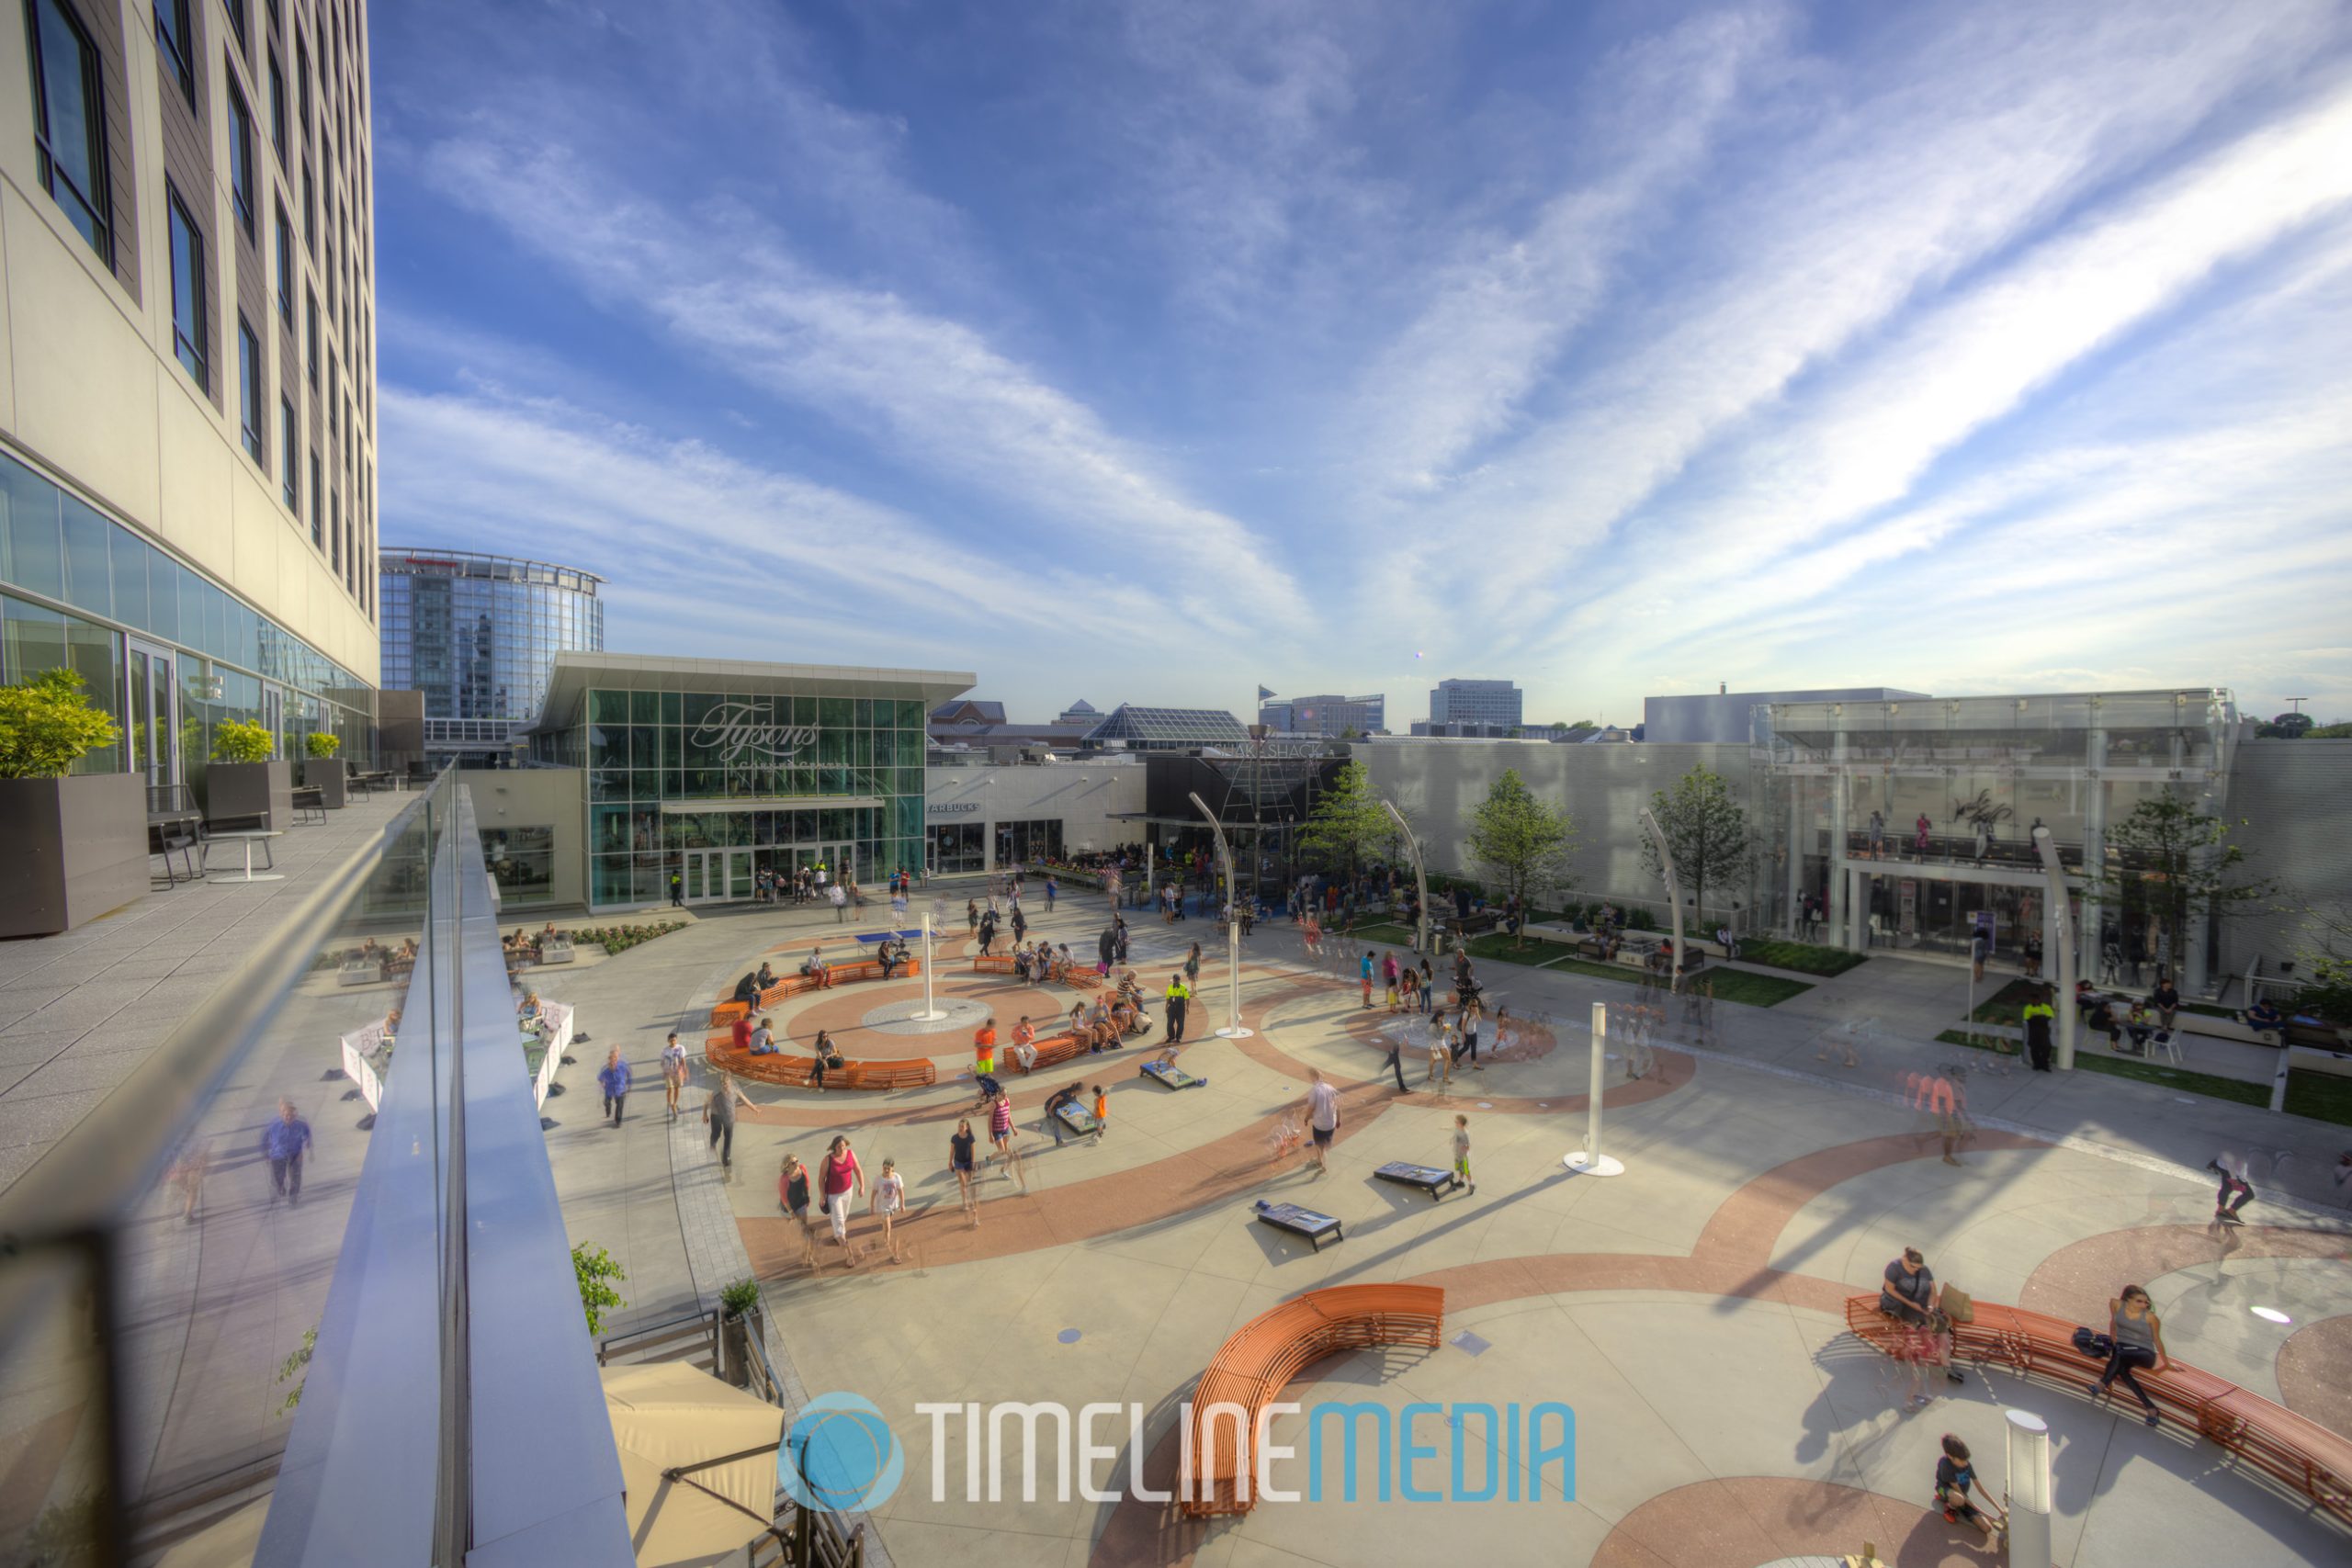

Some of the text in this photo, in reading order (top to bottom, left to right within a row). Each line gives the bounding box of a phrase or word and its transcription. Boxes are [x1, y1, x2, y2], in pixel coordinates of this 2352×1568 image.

[691, 702, 822, 761] Tysons
[1268, 743, 1321, 758] SHACK
[799, 761, 850, 771] CENTER
